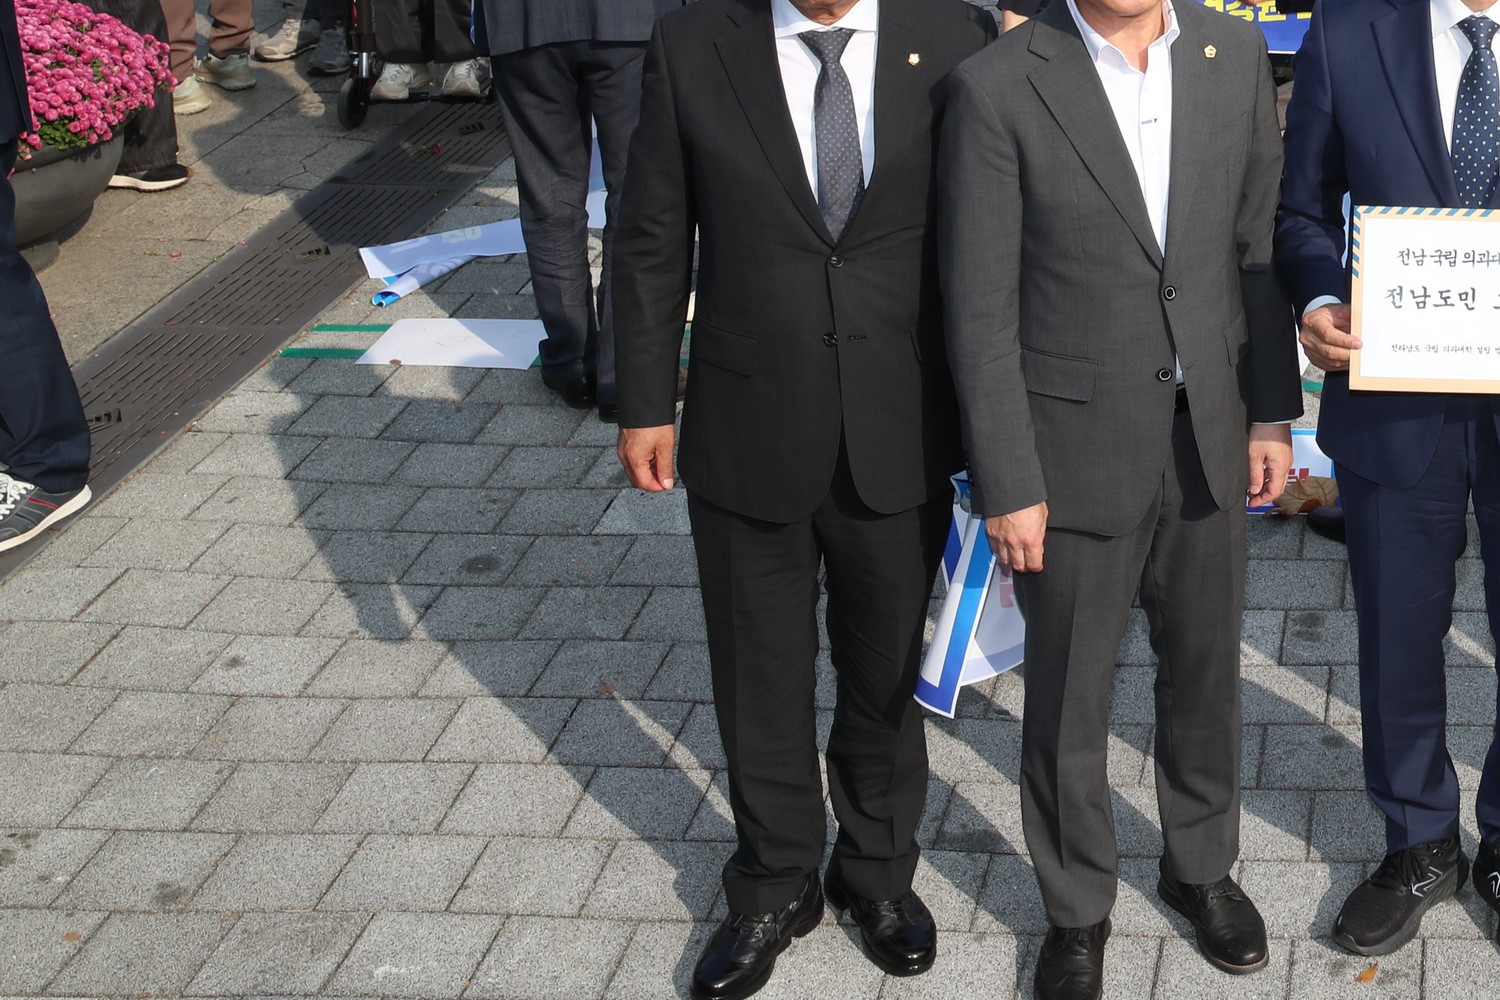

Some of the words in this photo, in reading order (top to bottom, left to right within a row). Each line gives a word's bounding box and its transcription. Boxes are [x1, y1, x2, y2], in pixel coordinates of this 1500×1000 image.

[1398, 248, 1425, 267] 전남
[1429, 249, 1458, 268] 국립
[1384, 285, 1478, 311] 전남도민
[1391, 344, 1421, 353] 전라남도
